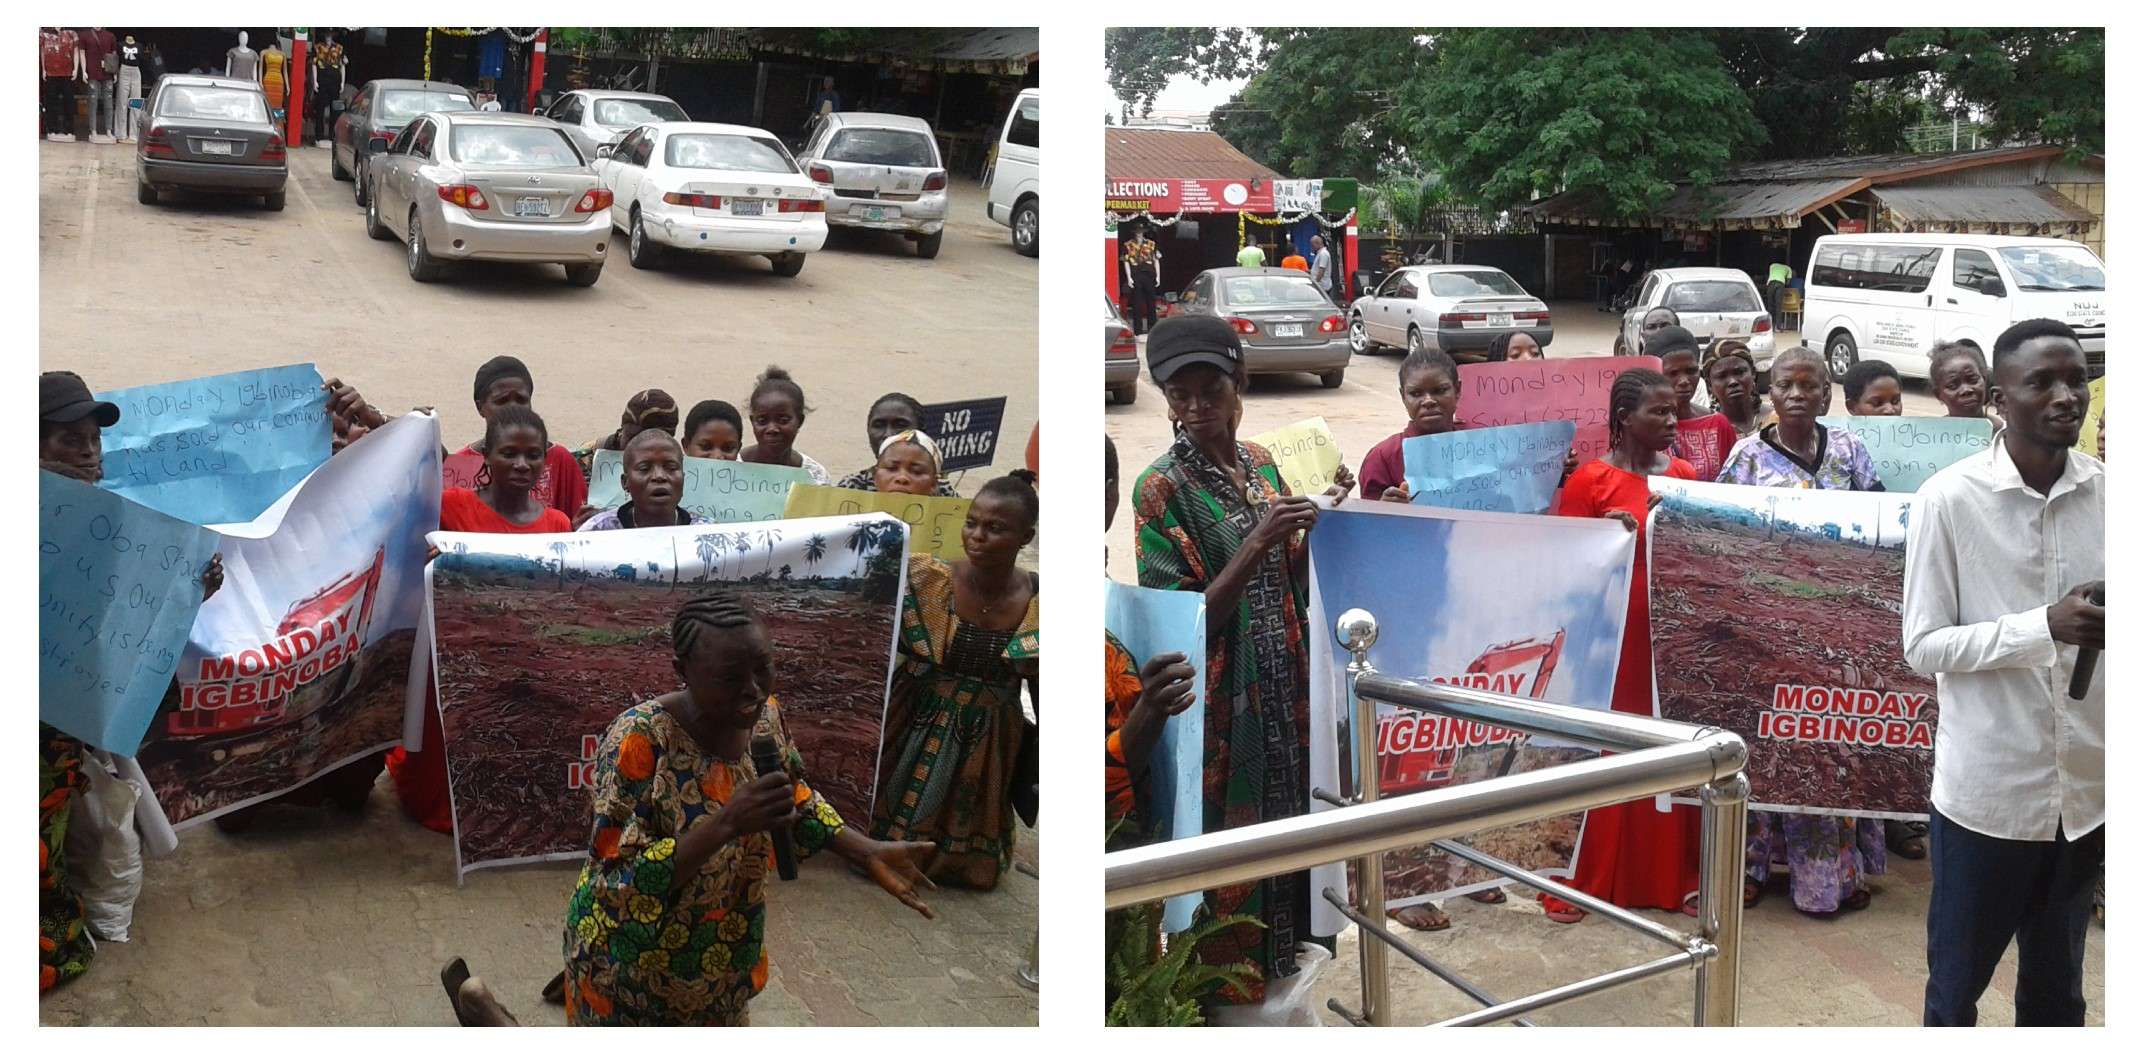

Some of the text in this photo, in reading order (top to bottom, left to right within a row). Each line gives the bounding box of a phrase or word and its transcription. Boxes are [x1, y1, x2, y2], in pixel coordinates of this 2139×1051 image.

[1105, 182, 1169, 197] LLECTIONS
[1105, 200, 1149, 209] PERMARKET
[941, 409, 971, 434] NO
[199, 604, 355, 683] MONDAY
[181, 631, 361, 710] IGBINOBA
[1428, 672, 1527, 696] NDAY
[1774, 684, 1928, 720] MONDAY
[1757, 710, 1933, 749] IGBINOBA
